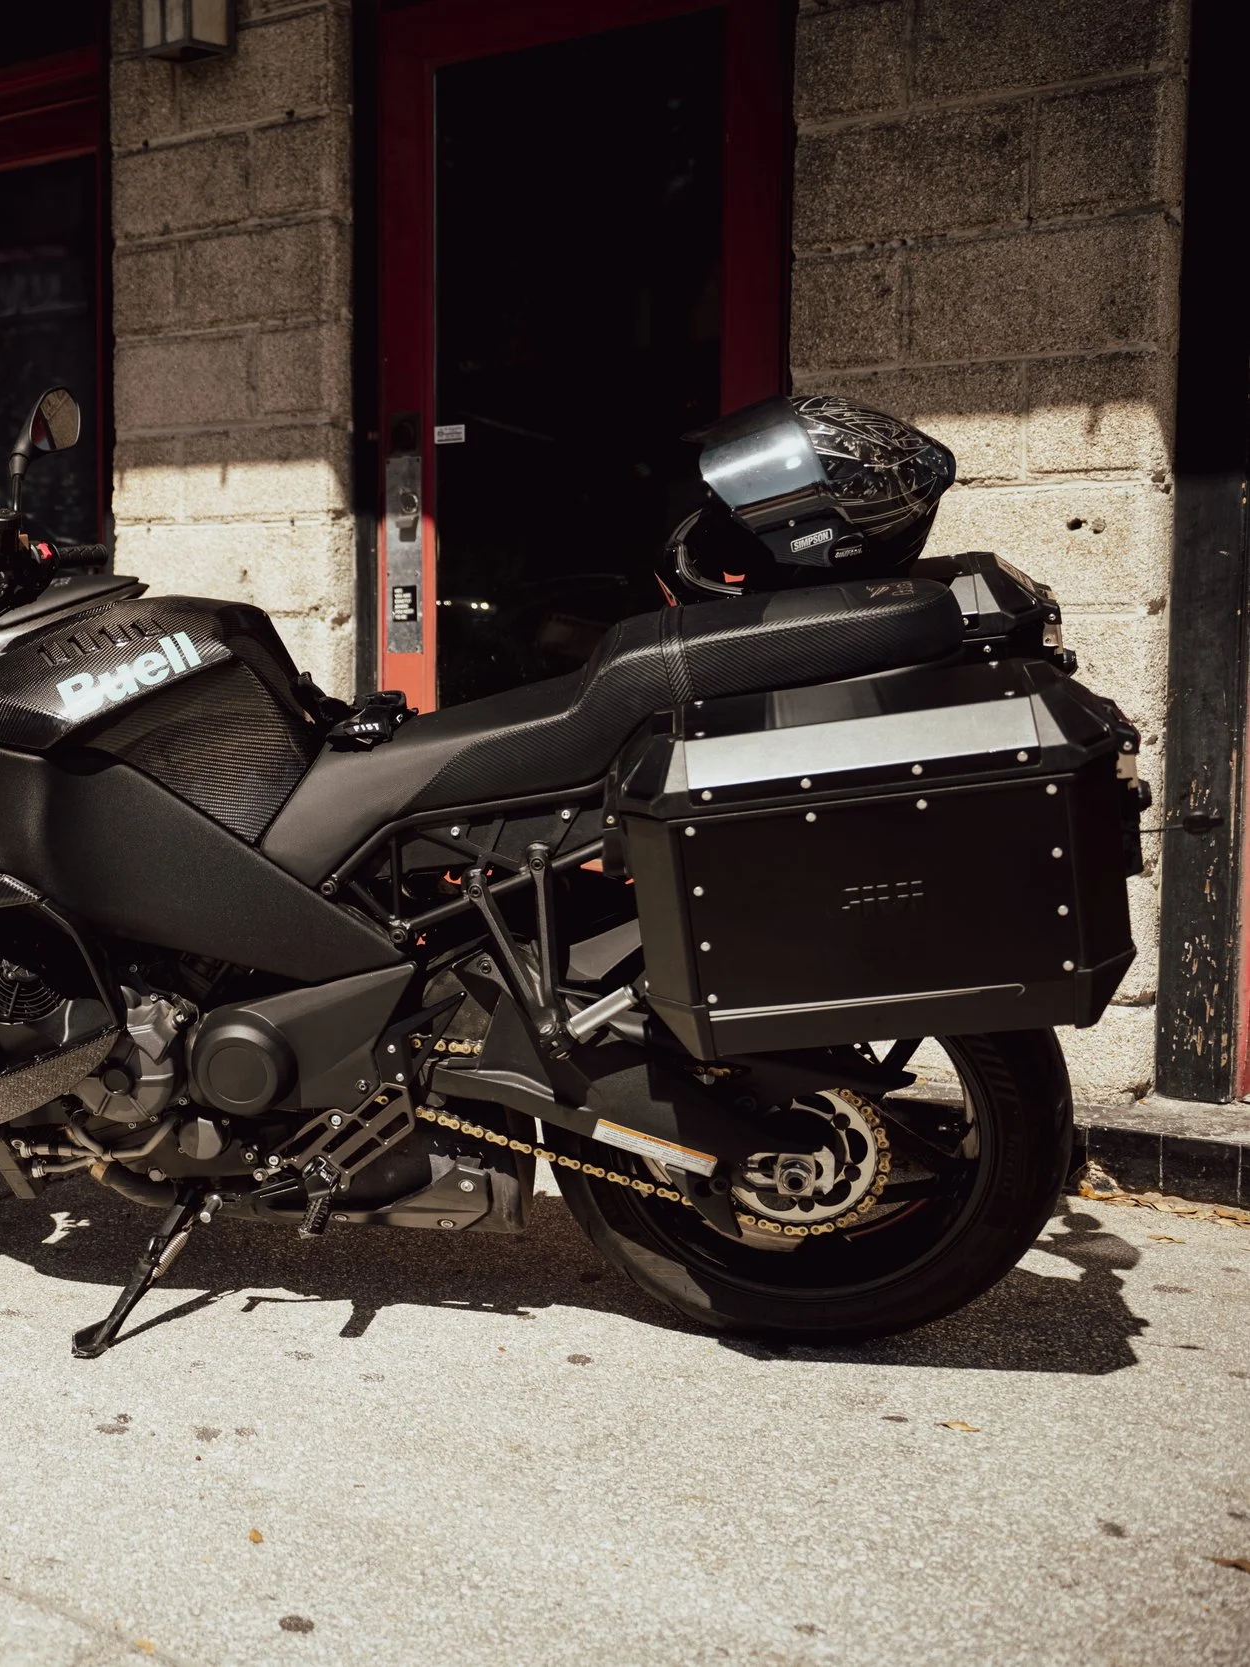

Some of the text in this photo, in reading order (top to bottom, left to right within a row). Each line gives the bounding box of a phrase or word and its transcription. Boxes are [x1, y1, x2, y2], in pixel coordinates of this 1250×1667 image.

[793, 530, 829, 551] SIMPSON
[55, 631, 204, 722] Buell
[353, 722, 380, 732] FIST
